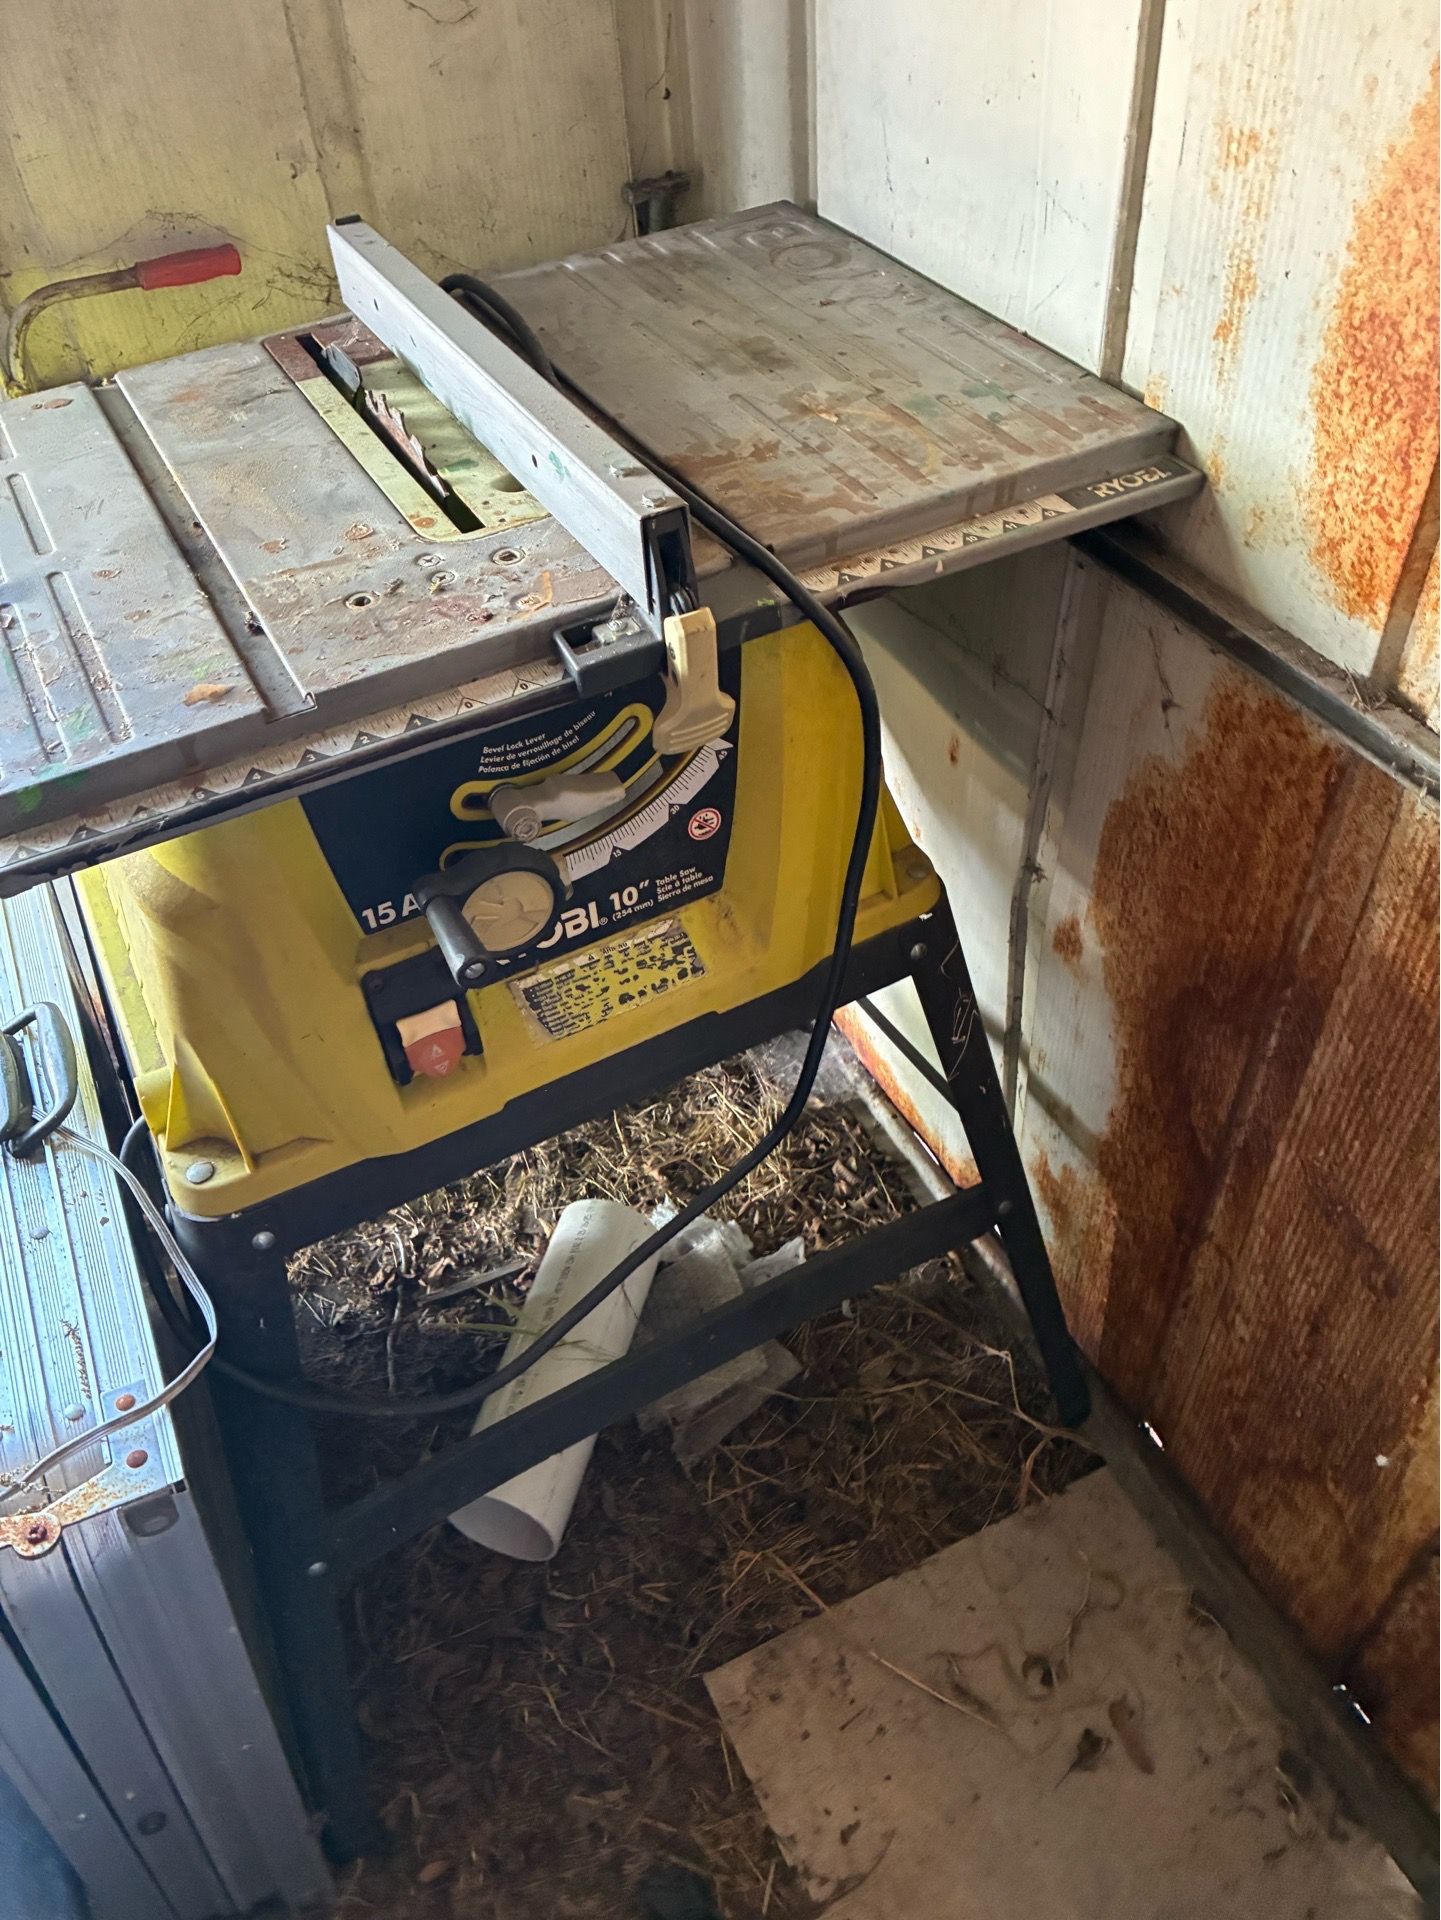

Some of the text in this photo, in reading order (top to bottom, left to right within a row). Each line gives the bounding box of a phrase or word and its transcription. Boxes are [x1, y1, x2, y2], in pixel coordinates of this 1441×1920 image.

[965, 535, 979, 543] 10
[1004, 522, 1018, 530] 11
[519, 682, 529, 690] 0
[306, 753, 316, 762] 3
[359, 735, 371, 744] 2
[413, 718, 422, 726] 1
[464, 701, 474, 709] 0
[478, 765, 509, 773] Palanca
[511, 762, 521, 770] de
[551, 748, 561, 756] de
[562, 735, 580, 750] bisel
[480, 756, 505, 764] Levier
[507, 752, 516, 761] de
[518, 735, 563, 758] verrouillage
[564, 729, 573, 738] de
[483, 733, 546, 754] Bevel Lock Lever
[719, 750, 728, 761] 45
[670, 805, 680, 814] 30
[655, 866, 696, 886] Table Saw
[656, 884, 673, 894] Scie
[682, 872, 703, 884] table
[658, 875, 714, 902] Sierra de mesa
[361, 892, 421, 929] 15 A
[612, 899, 654, 921] (254 mm)
